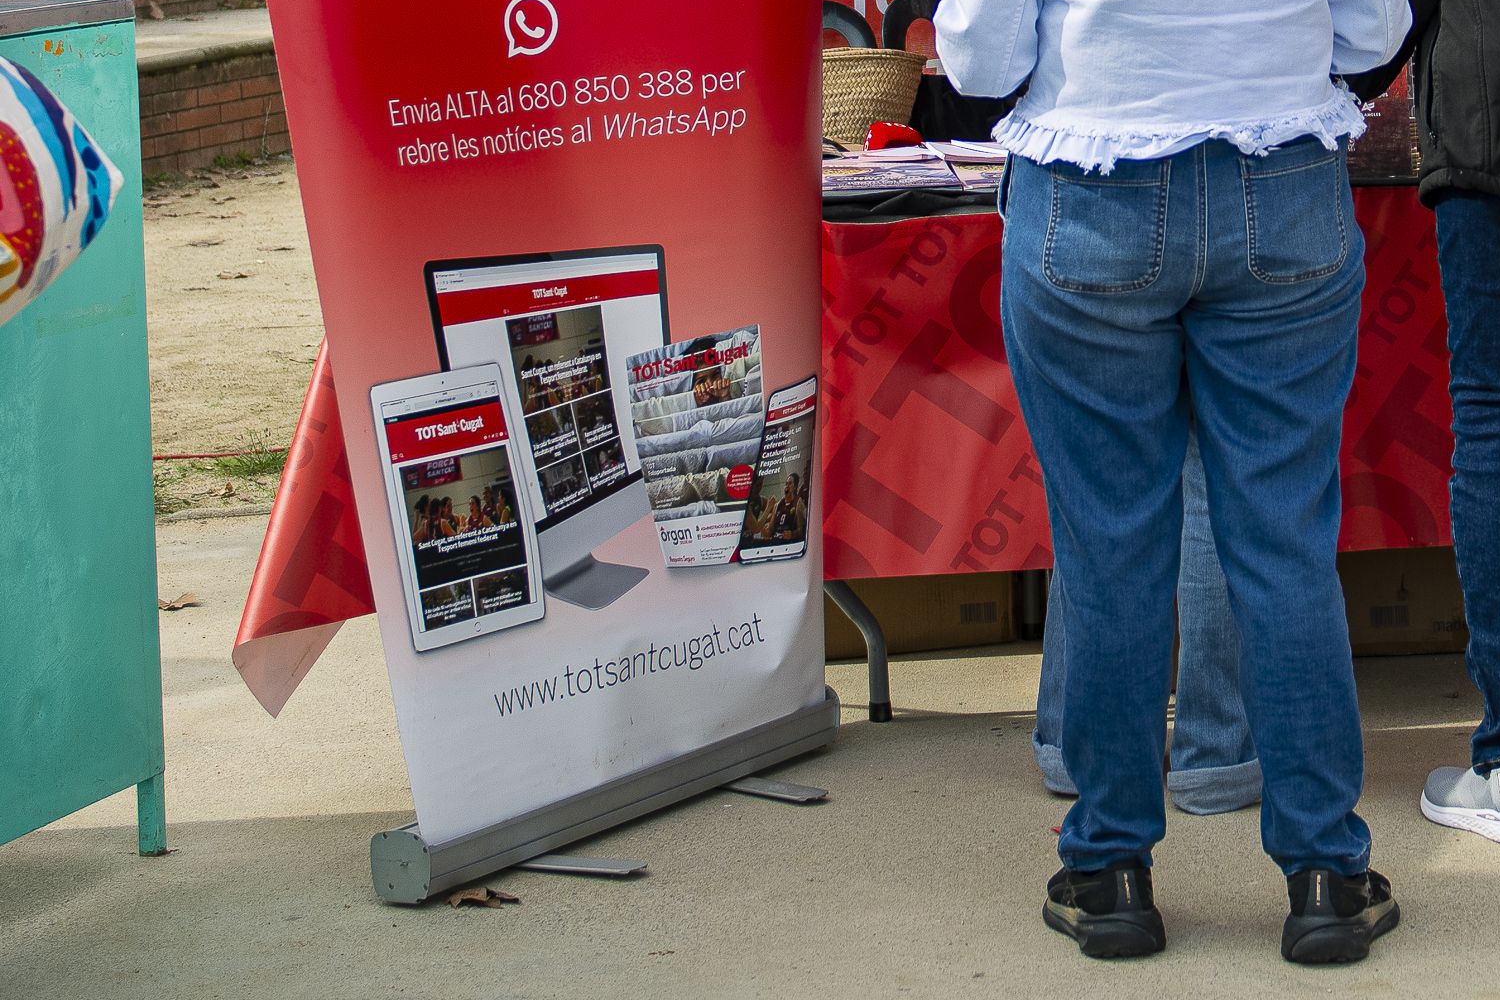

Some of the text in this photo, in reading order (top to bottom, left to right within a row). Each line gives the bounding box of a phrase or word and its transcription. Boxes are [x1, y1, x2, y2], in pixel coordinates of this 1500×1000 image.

[388, 69, 746, 127] Envia ALTA al 680 850 388 per
[398, 105, 747, 167] rebre les notícies al WhatsApp
[632, 341, 749, 382] TOT Sant Cugat
[415, 416, 484, 441] TOT Sant Cugat
[494, 612, 765, 717] www.totsantcugat.cat
